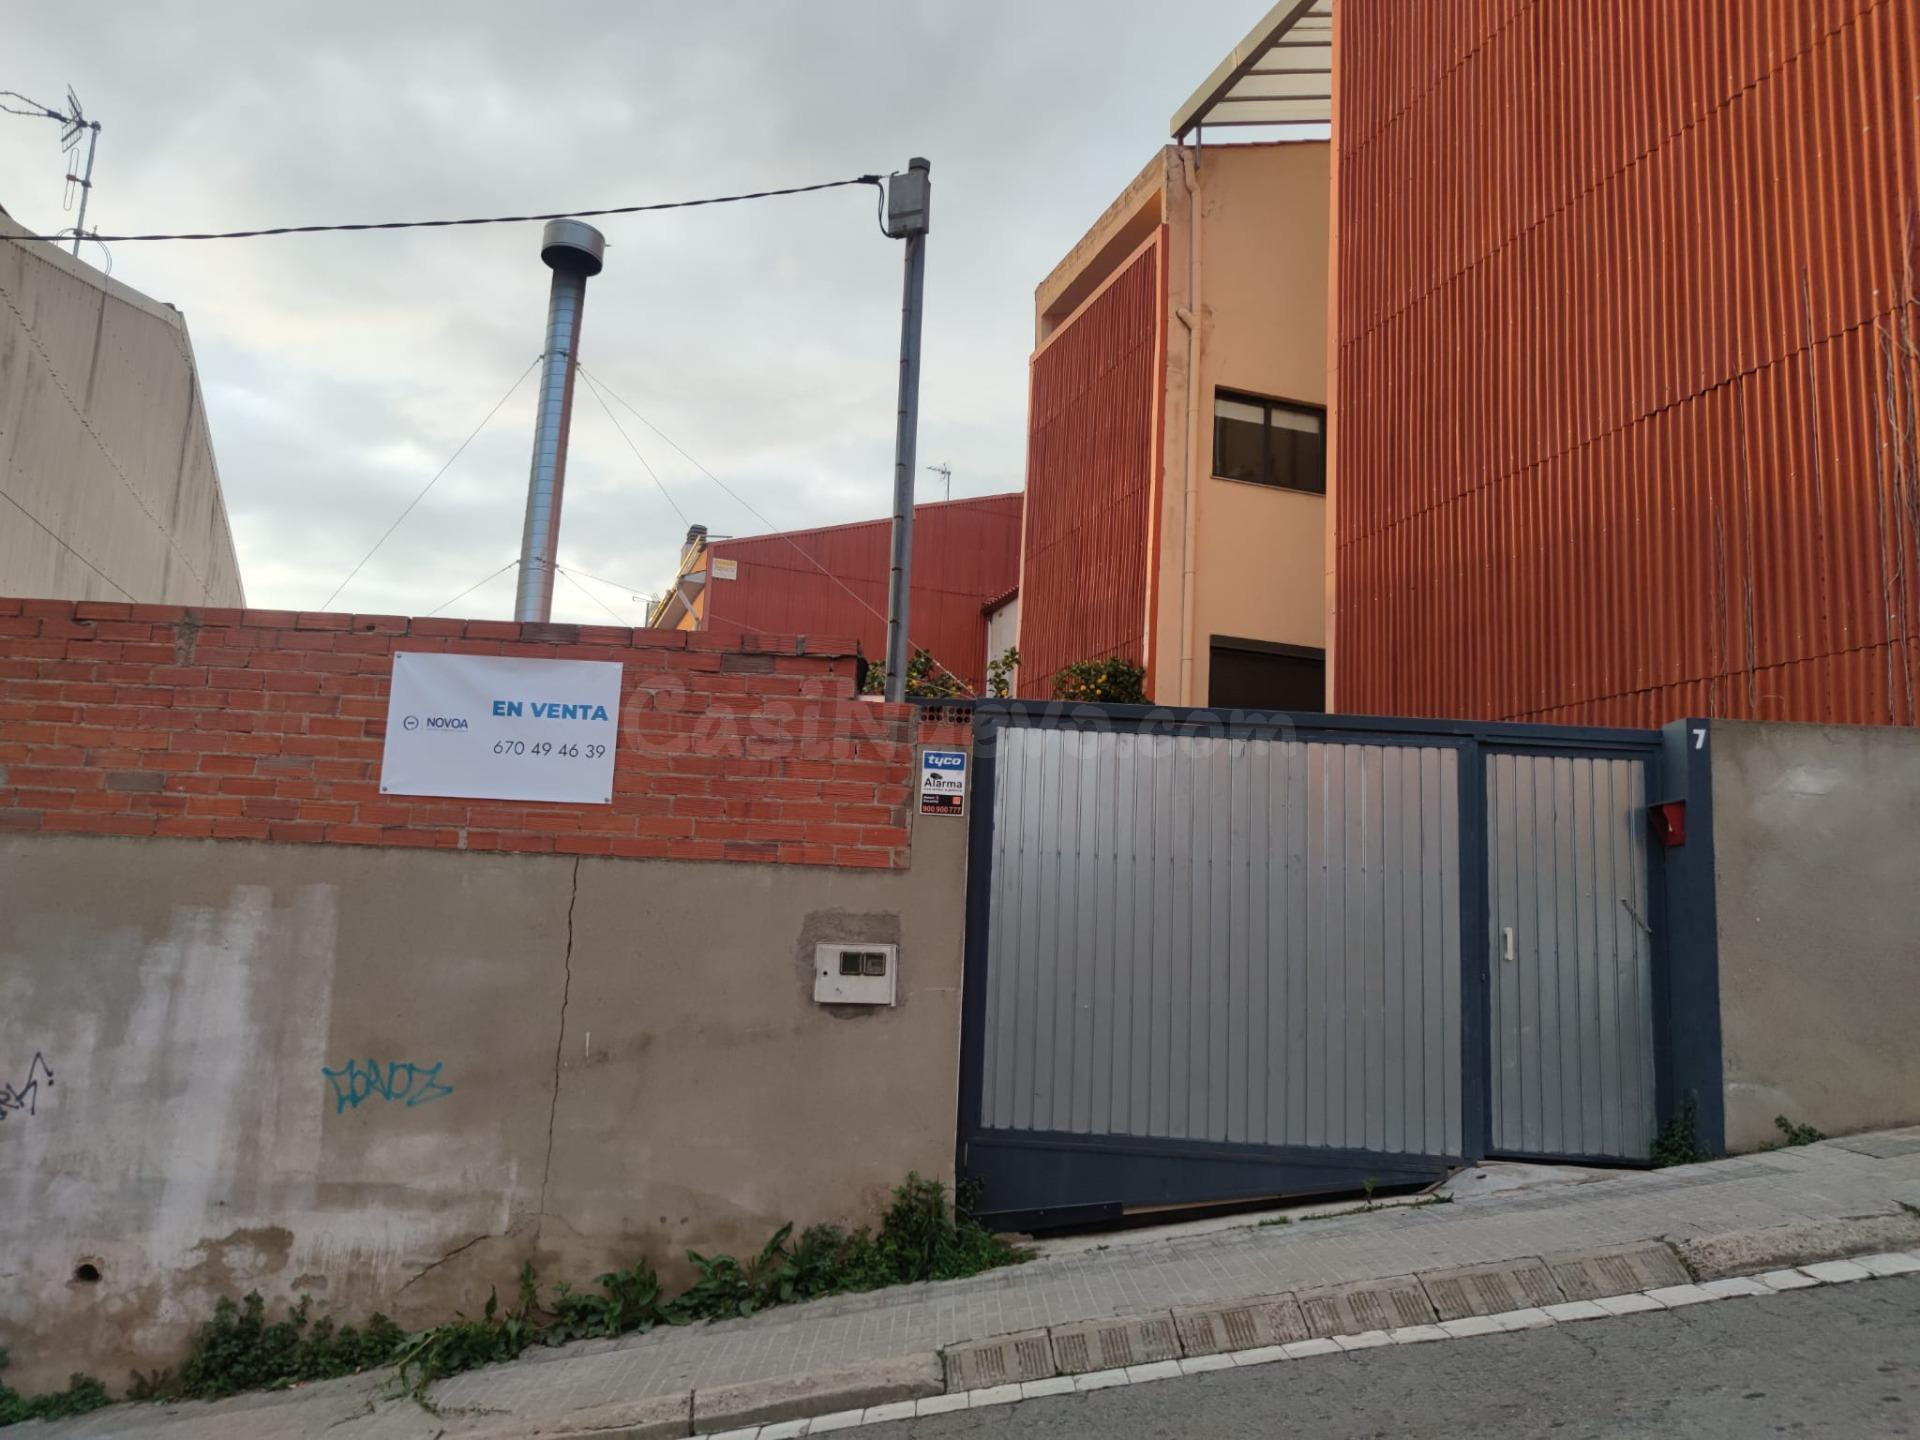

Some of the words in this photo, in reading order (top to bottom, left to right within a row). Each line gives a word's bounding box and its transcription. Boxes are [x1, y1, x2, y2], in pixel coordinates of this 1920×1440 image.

[493, 700, 522, 717] EN
[530, 702, 608, 721] VENTA
[427, 717, 468, 729] NOVOA
[1693, 729, 1706, 750] 7
[493, 740, 525, 755] 670
[531, 742, 552, 756] 49
[558, 744, 579, 758] 46
[585, 744, 606, 758] 39
[928, 755, 962, 767] tyco
[924, 777, 963, 789] Alarma
